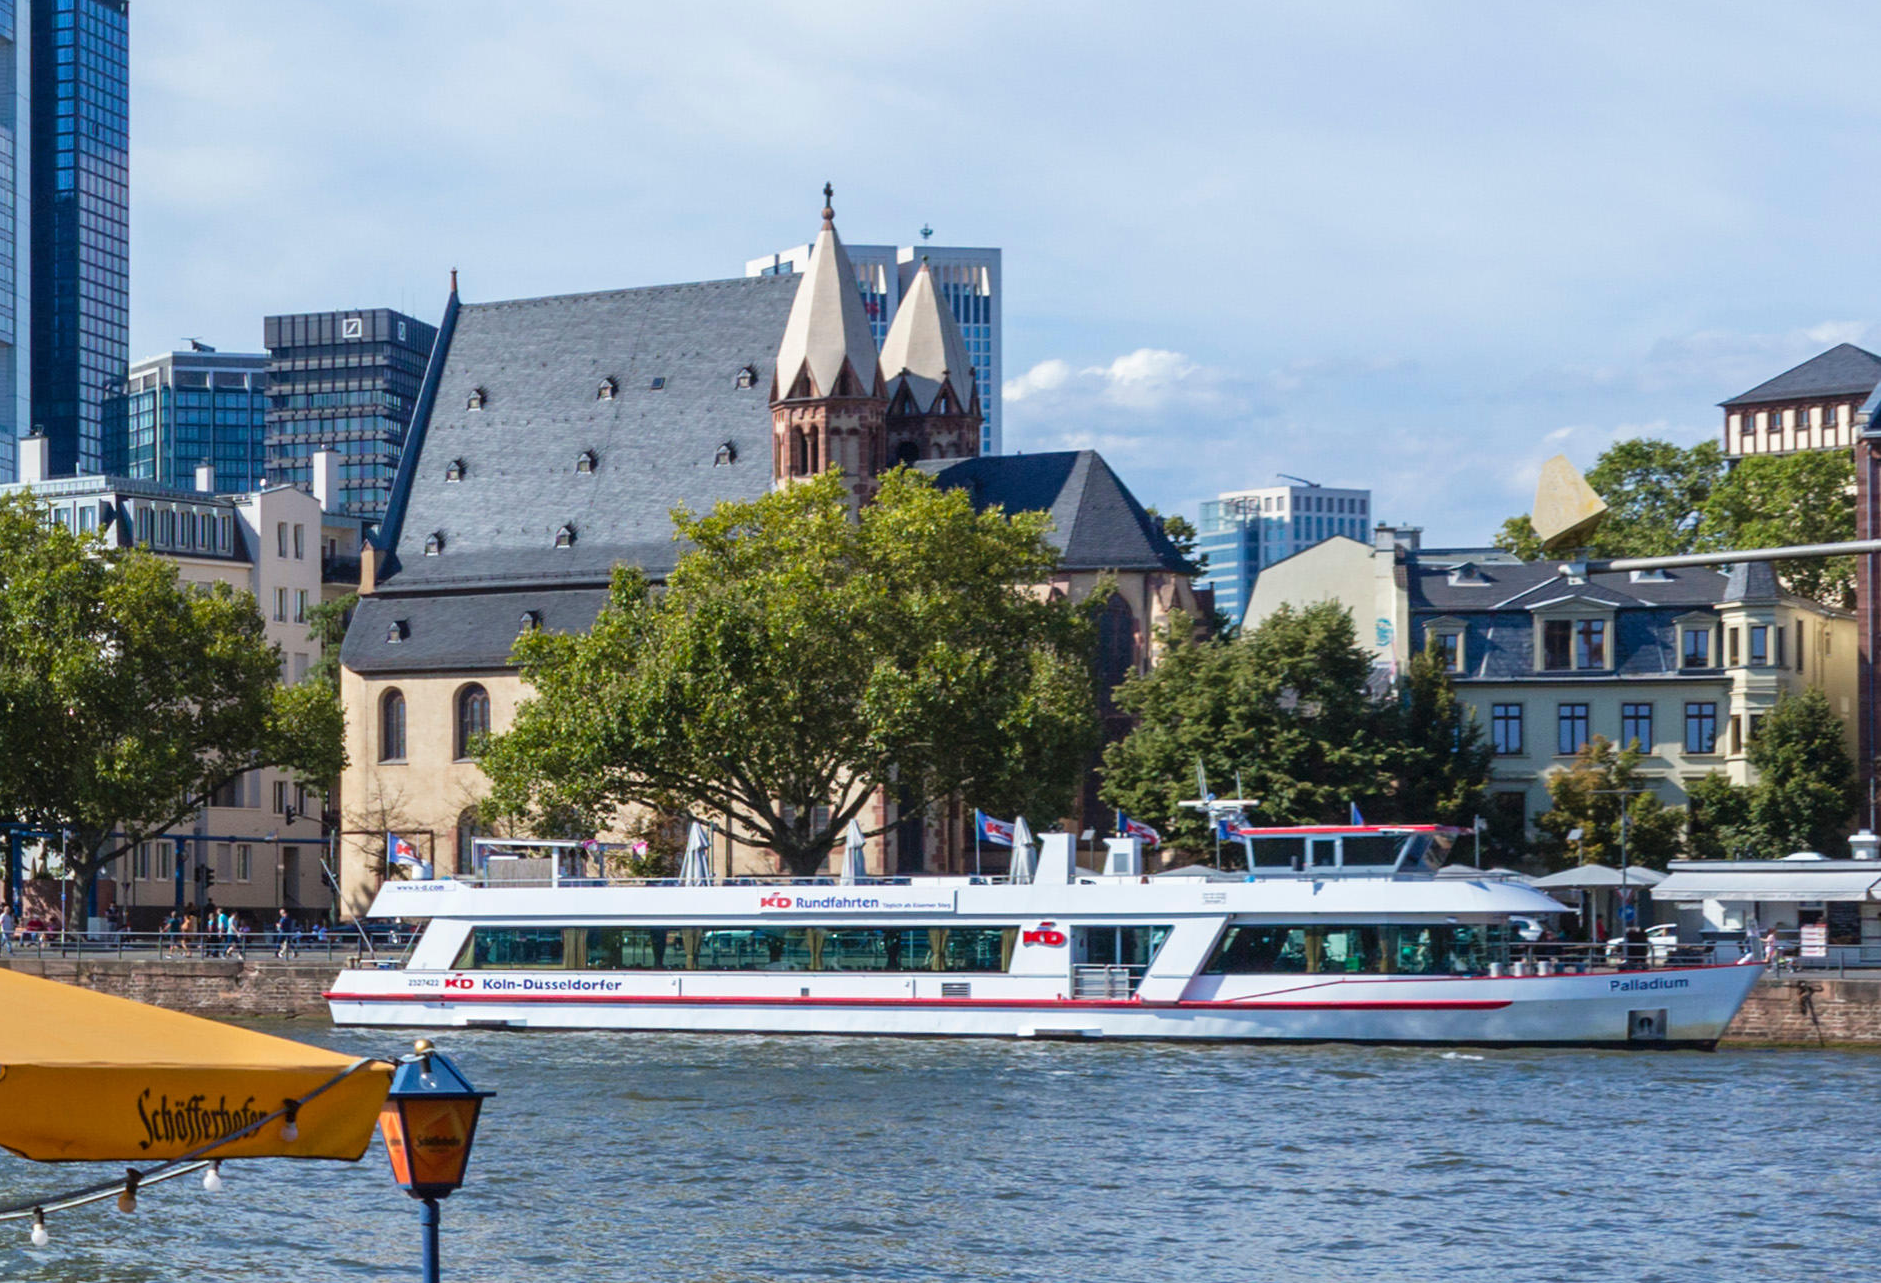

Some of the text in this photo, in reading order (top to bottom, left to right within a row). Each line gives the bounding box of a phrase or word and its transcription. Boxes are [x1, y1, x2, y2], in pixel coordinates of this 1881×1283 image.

[760, 893, 792, 909] KD
[796, 896, 879, 909] Rundfahrten
[1023, 924, 1067, 947] KD
[445, 975, 475, 989] KD
[482, 978, 623, 991] Köln-Düsseldorfer
[1610, 976, 1689, 992] Palladium
